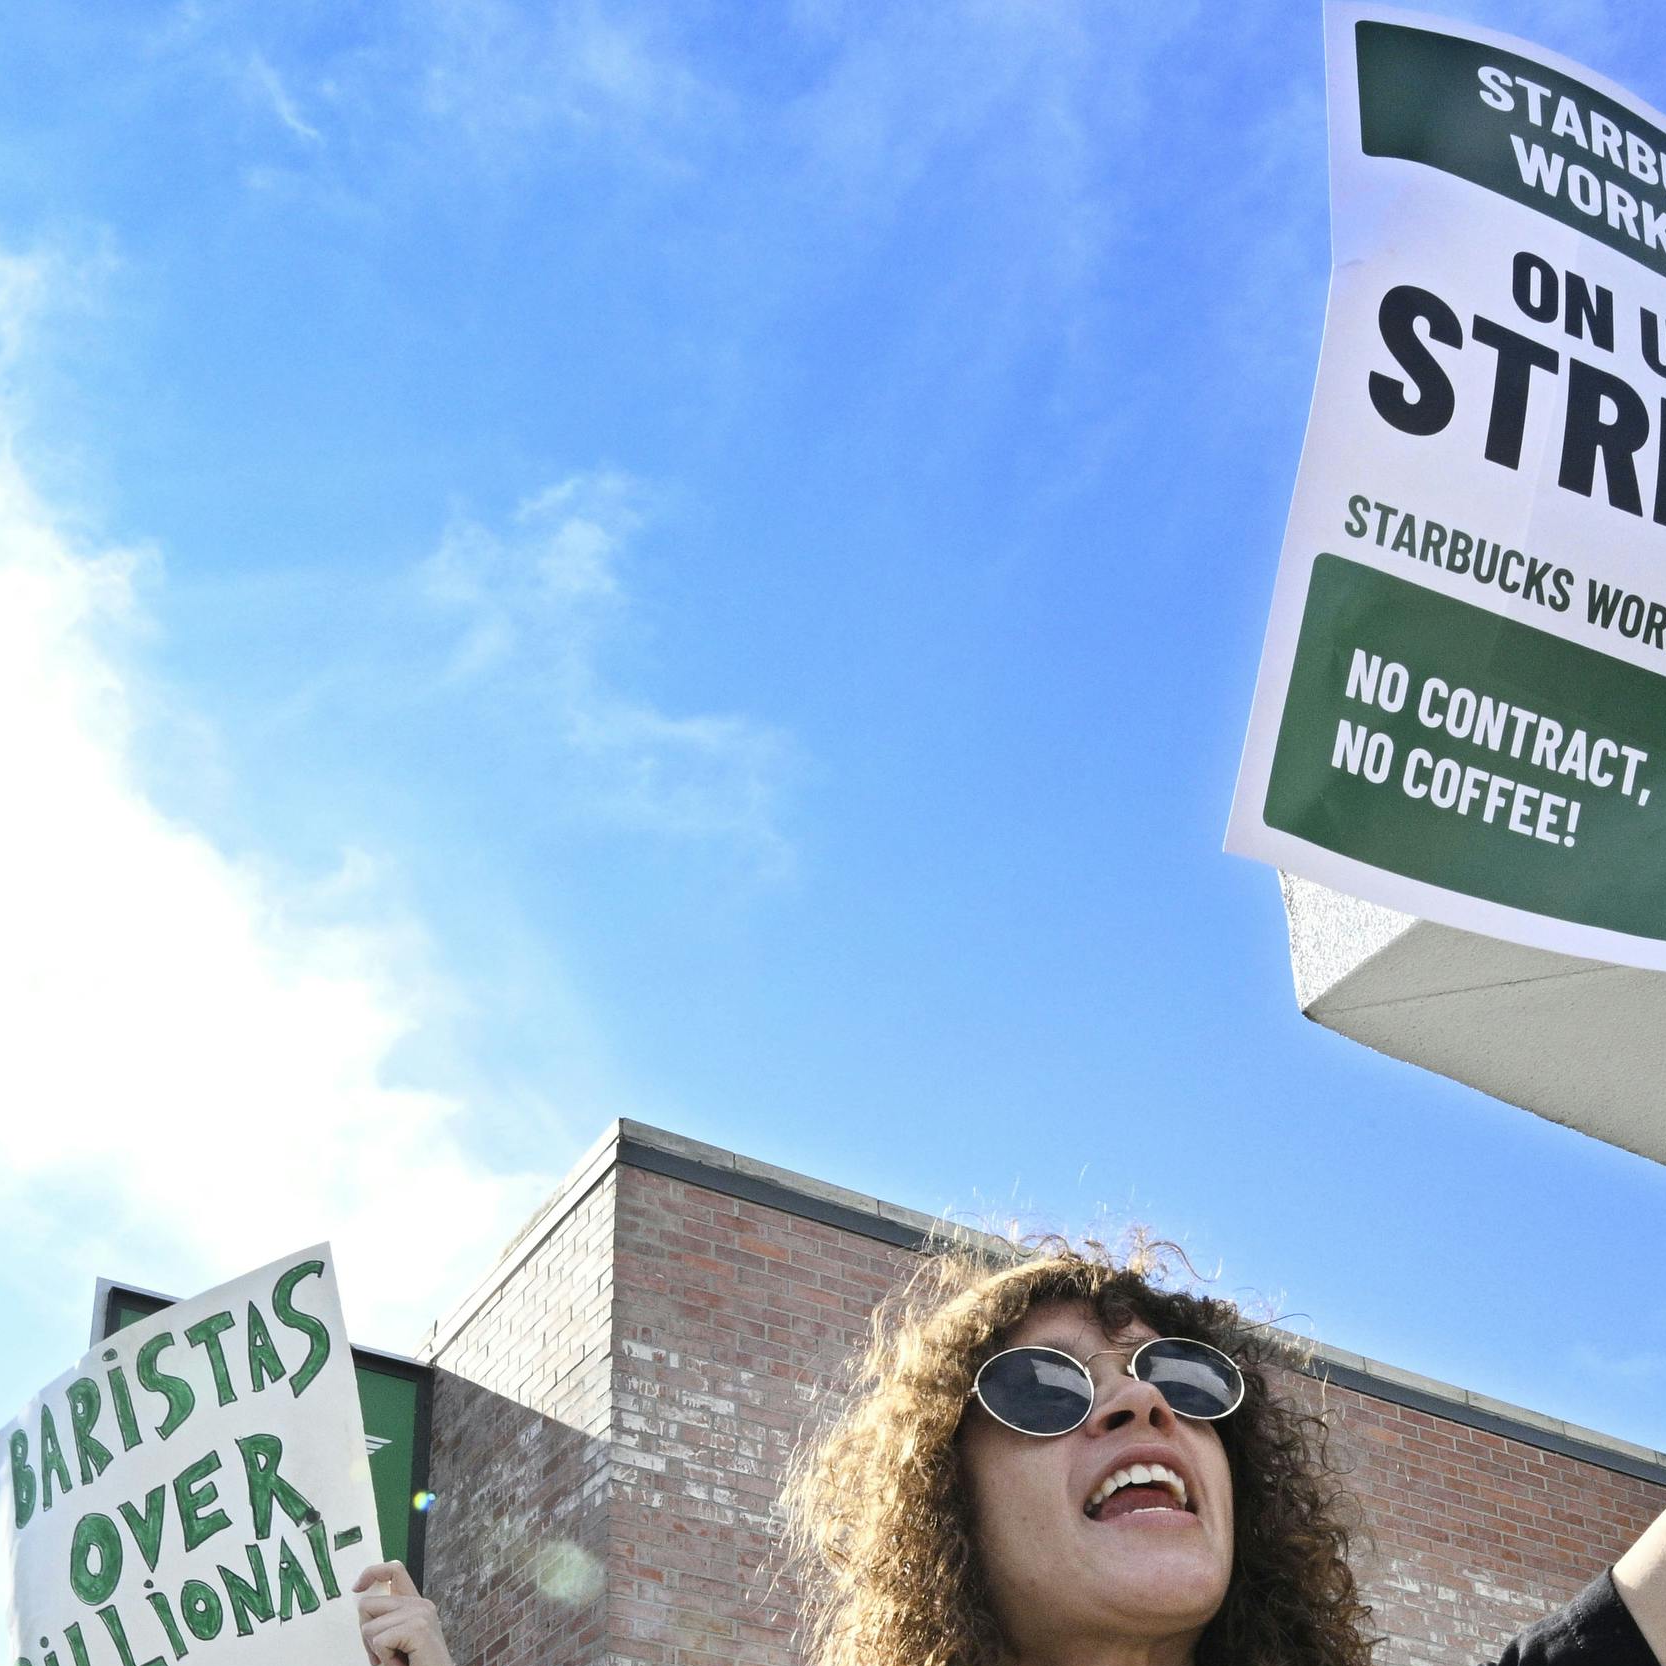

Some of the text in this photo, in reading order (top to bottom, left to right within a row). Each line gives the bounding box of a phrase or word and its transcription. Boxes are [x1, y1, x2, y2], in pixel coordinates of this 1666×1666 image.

[1512, 251, 1614, 352] ON
[1344, 494, 1575, 613] STARBUCKS
[1331, 719, 1581, 848] NO COFFEE!
[1345, 648, 1651, 806] NO CONTRACT,
[70, 1433, 319, 1605] OVER
